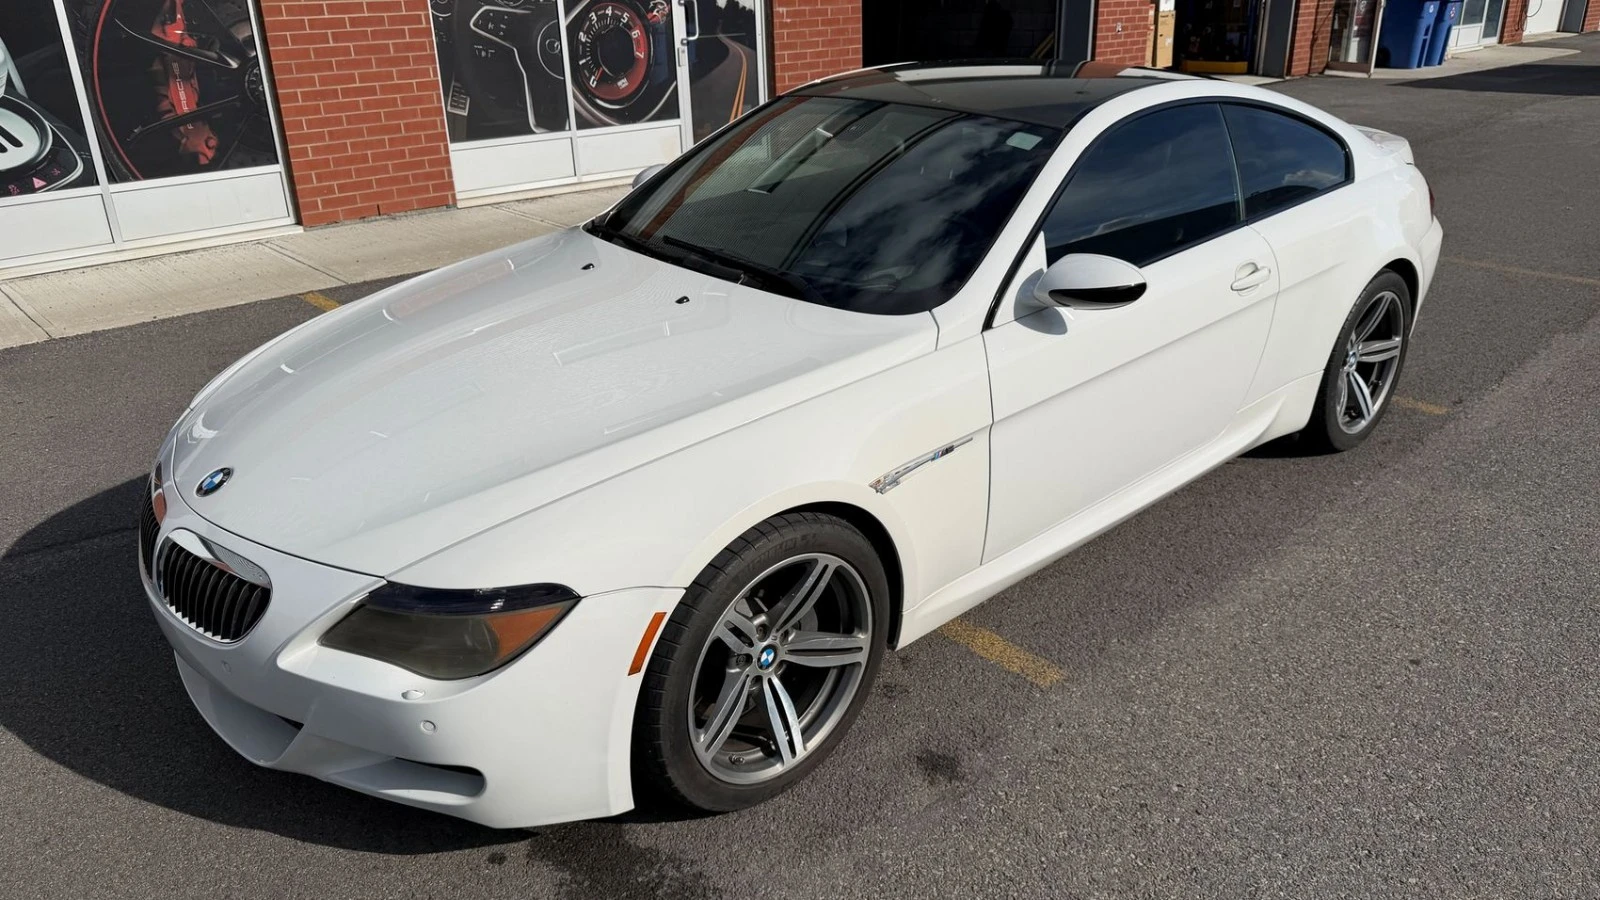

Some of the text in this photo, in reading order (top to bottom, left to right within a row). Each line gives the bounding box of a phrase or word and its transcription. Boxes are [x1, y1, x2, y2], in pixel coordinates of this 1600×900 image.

[605, 5, 612, 16] 4
[589, 12, 597, 24] 3
[620, 12, 629, 23] 5
[578, 31, 587, 42] 2
[631, 29, 641, 39] 6
[635, 51, 645, 59] 7
[171, 61, 194, 129] PRSCHE
